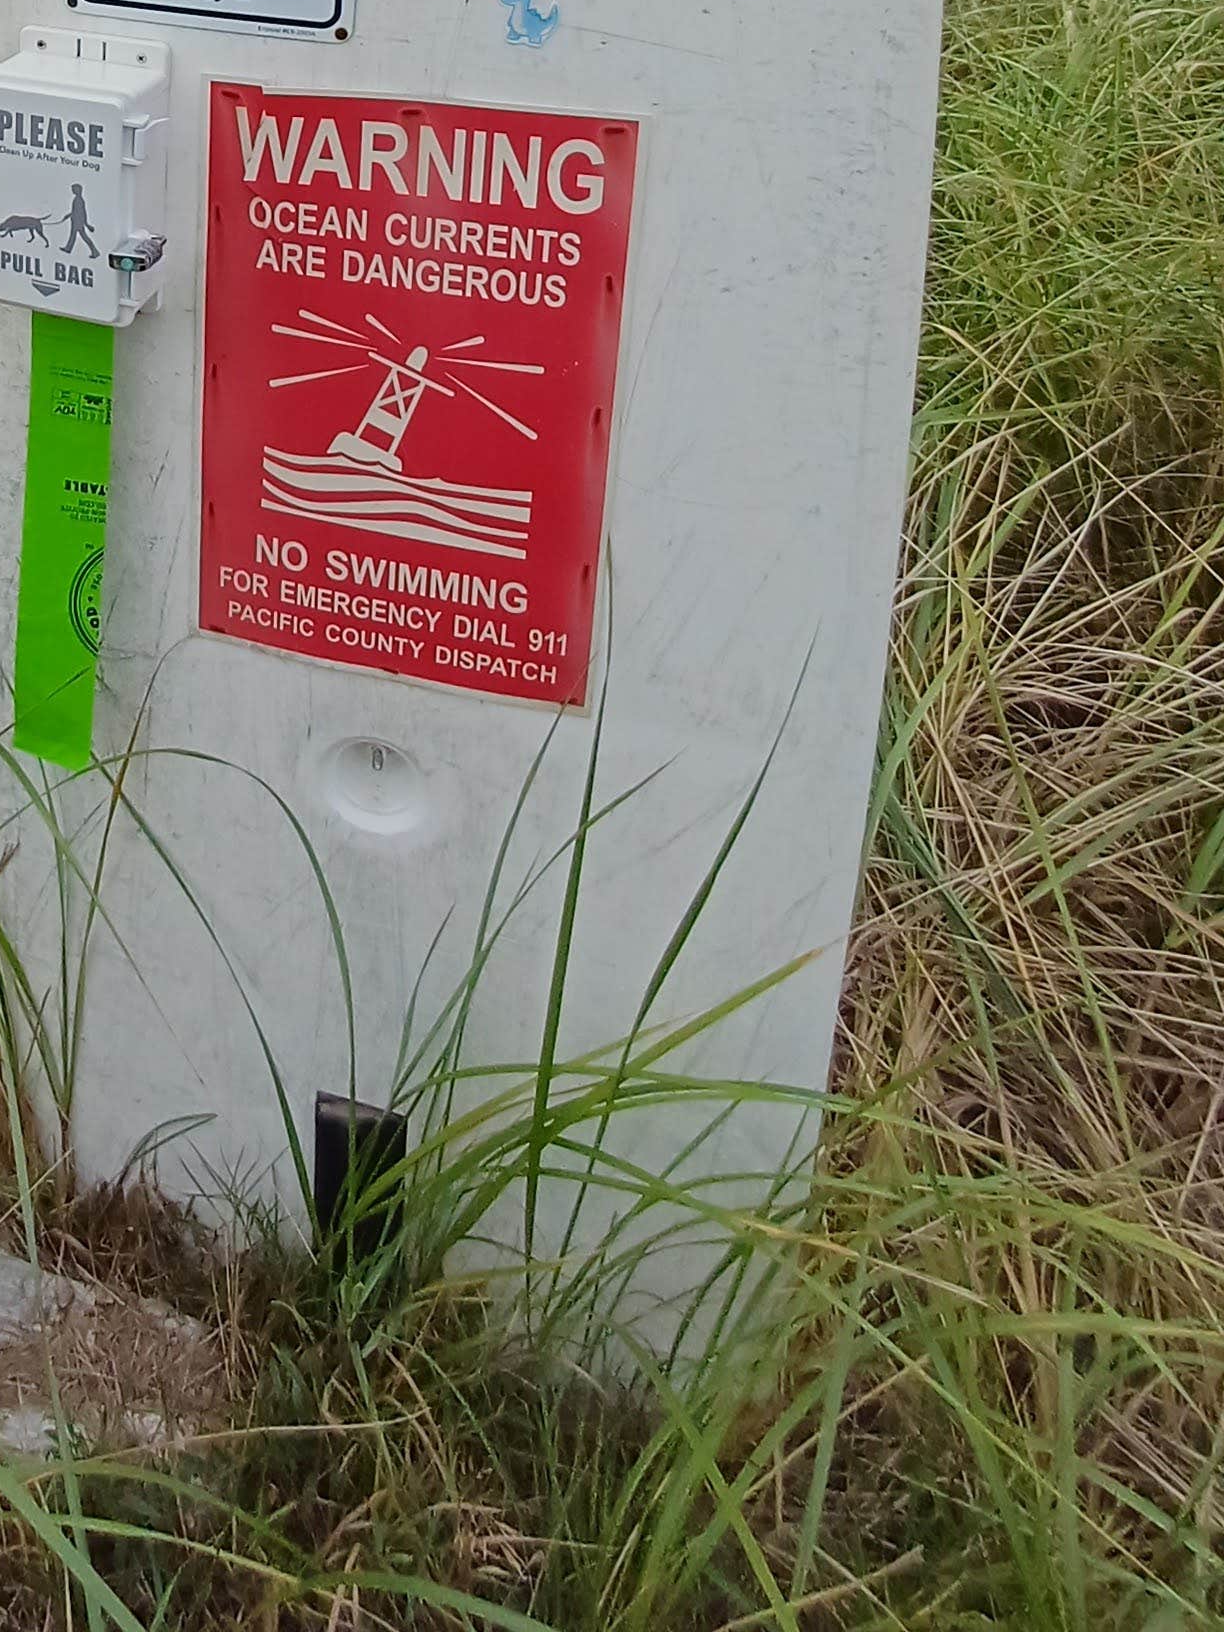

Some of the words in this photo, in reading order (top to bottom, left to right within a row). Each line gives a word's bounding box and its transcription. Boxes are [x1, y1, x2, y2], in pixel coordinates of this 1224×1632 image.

[22, 150, 34, 160] Up
[36, 152, 59, 163] After
[60, 156, 80, 167] Your
[82, 160, 101, 172] Dog
[235, 105, 605, 215] WARNING
[248, 196, 368, 241] OCEAN
[385, 213, 581, 266] CURRENTS
[0, 251, 44, 278] PULL
[54, 262, 94, 288] BAG
[256, 240, 326, 278] ARE
[342, 250, 567, 308] DANGEROUS
[64, 479, 107, 497] TABLE
[255, 534, 308, 572] NO
[325, 550, 528, 614] SWIMMING
[219, 566, 269, 598] FOR
[280, 583, 441, 633] EMERGENCY
[453, 614, 515, 648] DIAL
[528, 628, 568, 656] 911
[227, 600, 315, 637] PACIFIC
[325, 624, 424, 660] COUNTY
[435, 646, 557, 684] DISPATCH
